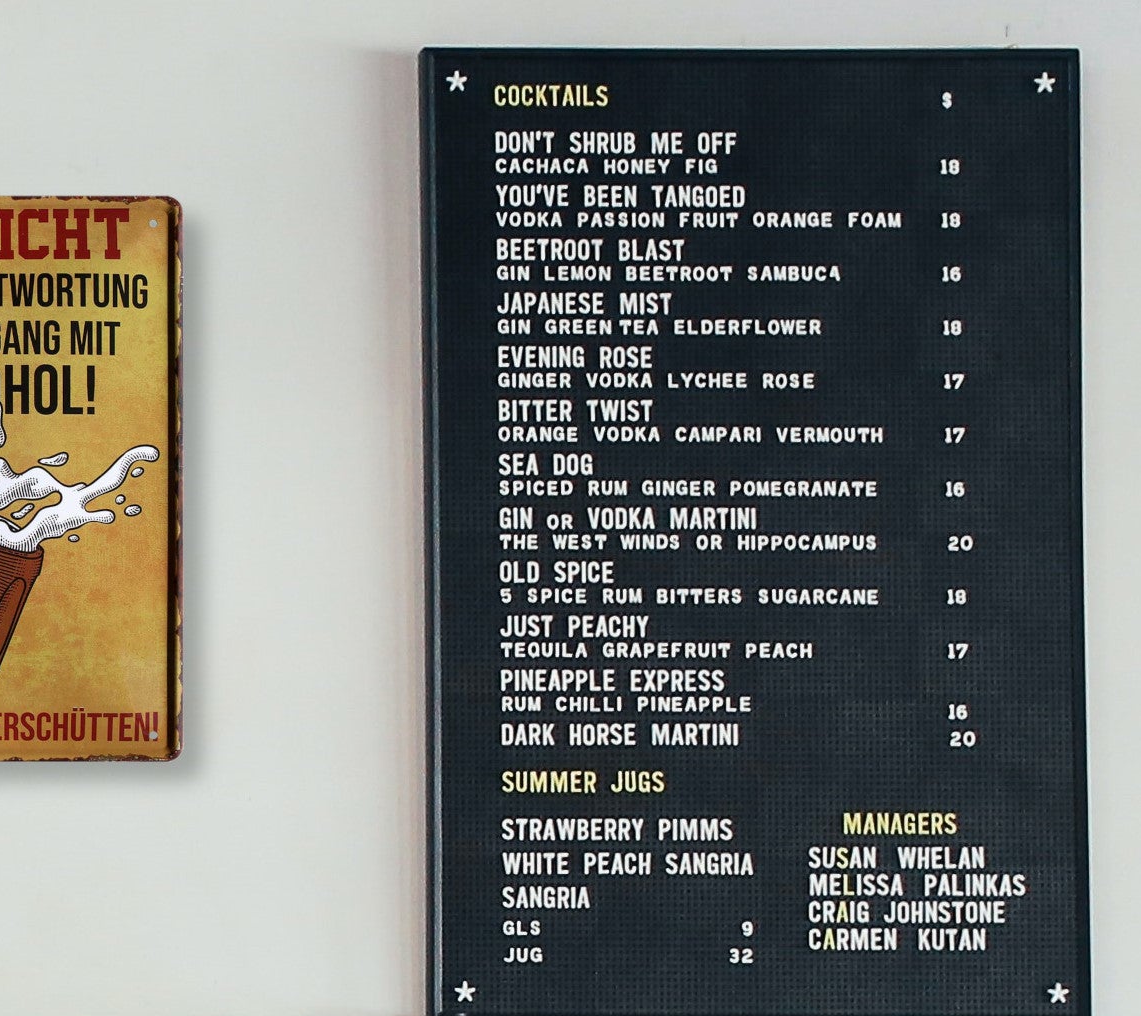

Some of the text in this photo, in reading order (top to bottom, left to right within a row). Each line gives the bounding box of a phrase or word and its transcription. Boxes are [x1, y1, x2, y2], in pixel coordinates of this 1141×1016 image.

[495, 85, 608, 106] COCKTAILS
[495, 131, 736, 154] DON'T SHRUB ME OFF
[496, 158, 717, 174] CACHACA HONEY FIG
[941, 159, 959, 175] 18
[496, 184, 745, 208] YOU'VE BEEN TANGOED
[496, 212, 901, 228] VODKA PASSION FRUIT ORANGE FOAM
[942, 213, 960, 228] 18
[497, 239, 684, 261] BEETROOT BLAST
[497, 266, 529, 281] GIN
[545, 266, 611, 281] LEMON
[626, 266, 732, 281] BEETROOT
[942, 267, 961, 282] 16
[497, 292, 671, 315] JAPANESE MIST
[498, 319, 821, 335] GIN GREEN TEA ELDERFLOWER
[943, 320, 961, 335] 18
[70, 321, 121, 356] MIT
[498, 346, 652, 369] EVENING ROSE
[498, 373, 814, 389] GINGER VODKA LYCHEE ROSE
[944, 374, 964, 389] 17
[499, 400, 652, 422] BITTER TWIST
[498, 426, 883, 443] ORANGE VODKA CAMPARI VERMOUTH
[945, 428, 965, 443] 17
[499, 454, 593, 475] SEA DOG
[500, 480, 877, 497] SPICED RUM GINGER POMEGRANATE
[946, 481, 964, 497] 16
[500, 507, 756, 530] GIN OR VODKA MARTINI
[500, 534, 876, 551] THE WEST WINDS OR HIPPOCAMPUS
[948, 536, 973, 551] 20
[500, 561, 613, 583] OLD SPICE
[500, 588, 878, 605] 5 SPICE RUM BITTERS SUGARCANE
[948, 589, 966, 604] 18
[500, 615, 648, 638] JUST PEACHY
[501, 642, 812, 658] TEQUILA GRAPEFRUIT PEACH
[948, 644, 968, 659] 17
[501, 669, 724, 692] PINEAPPLE EXPRESS
[502, 696, 751, 712] RUM CHILLI PINEAPPLE
[948, 704, 967, 720] 16
[502, 723, 738, 746] DARK HORSE MARTINI
[950, 731, 976, 747] 20
[502, 771, 664, 793] SUMMER JUGS
[502, 818, 733, 841] STRAWBERRY PIMMS
[844, 813, 957, 835] MANAGERS
[503, 852, 753, 875] WHITE PEACH SANGRIA
[809, 846, 984, 869] SUSAN WHELAN
[810, 874, 1026, 897] MELISSA PALINKAS
[503, 886, 590, 909] SANGRIA
[809, 901, 1005, 923] CRAIG JOHNSTONE
[503, 921, 540, 935] GLS
[742, 921, 753, 936] 9
[809, 928, 985, 951] CARMEN KUTAN
[504, 947, 542, 962] JUG
[730, 948, 753, 963] 32
